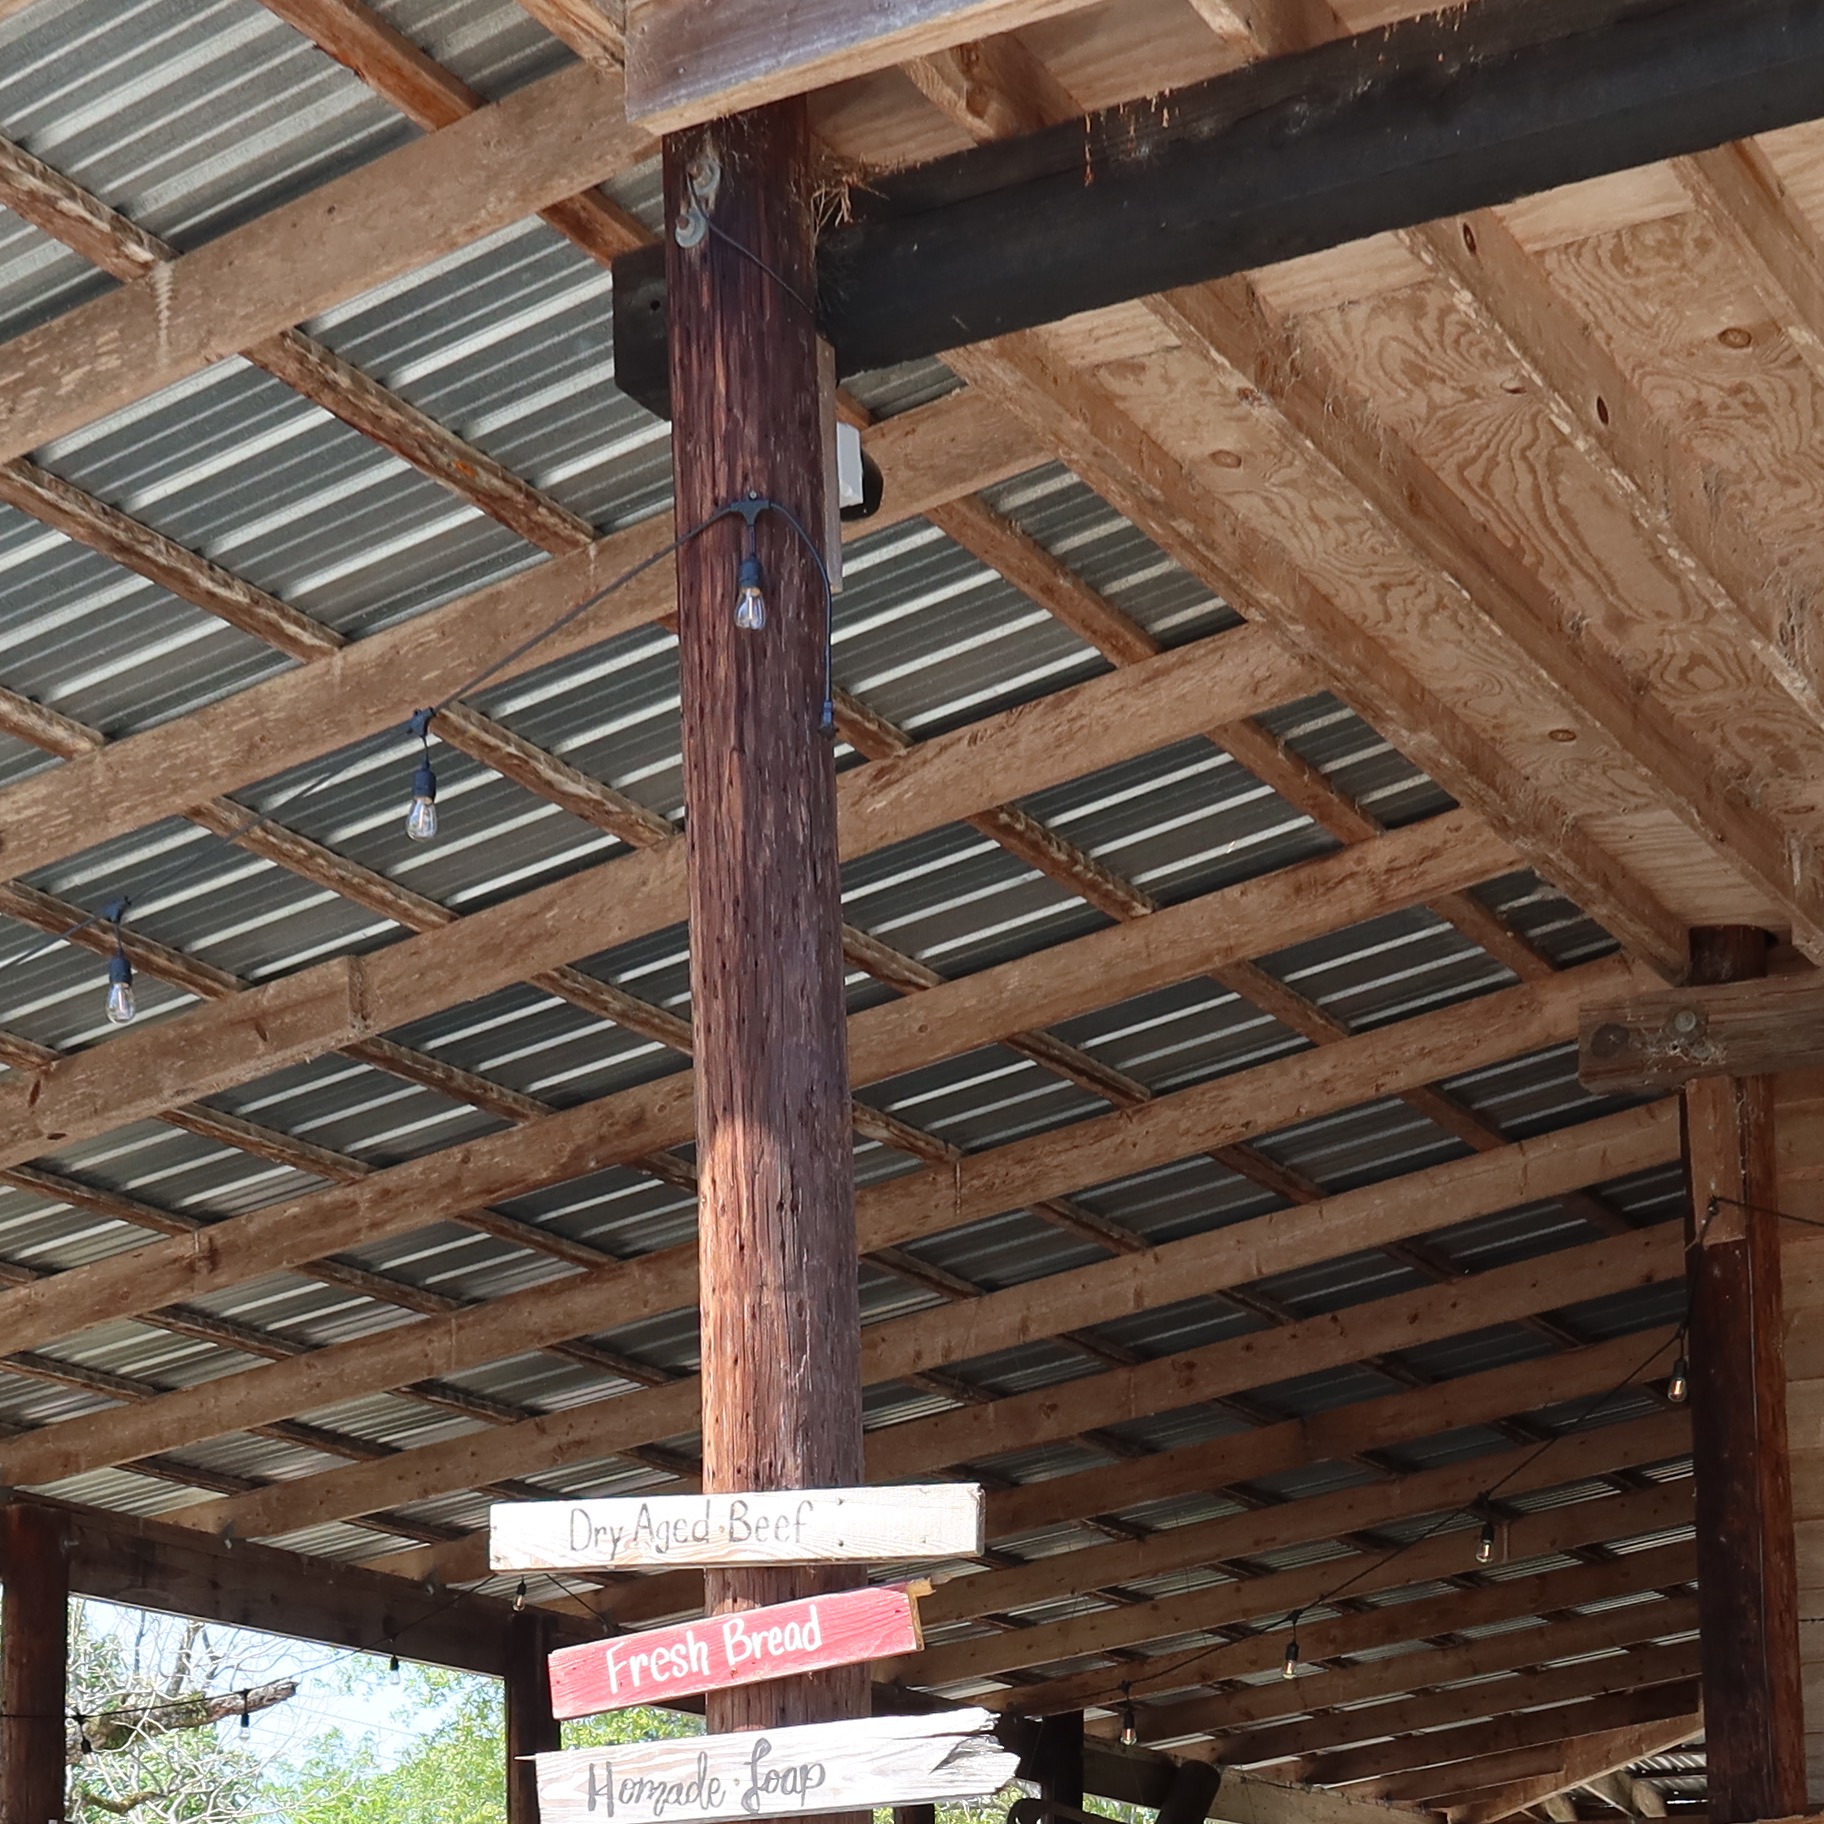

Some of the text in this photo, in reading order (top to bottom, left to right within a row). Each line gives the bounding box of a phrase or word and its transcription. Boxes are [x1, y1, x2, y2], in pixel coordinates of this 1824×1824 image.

[569, 1499, 814, 1561] Dry Aged Beef
[606, 1603, 824, 1695] Fresh Bread
[739, 1736, 826, 1815] Soap
